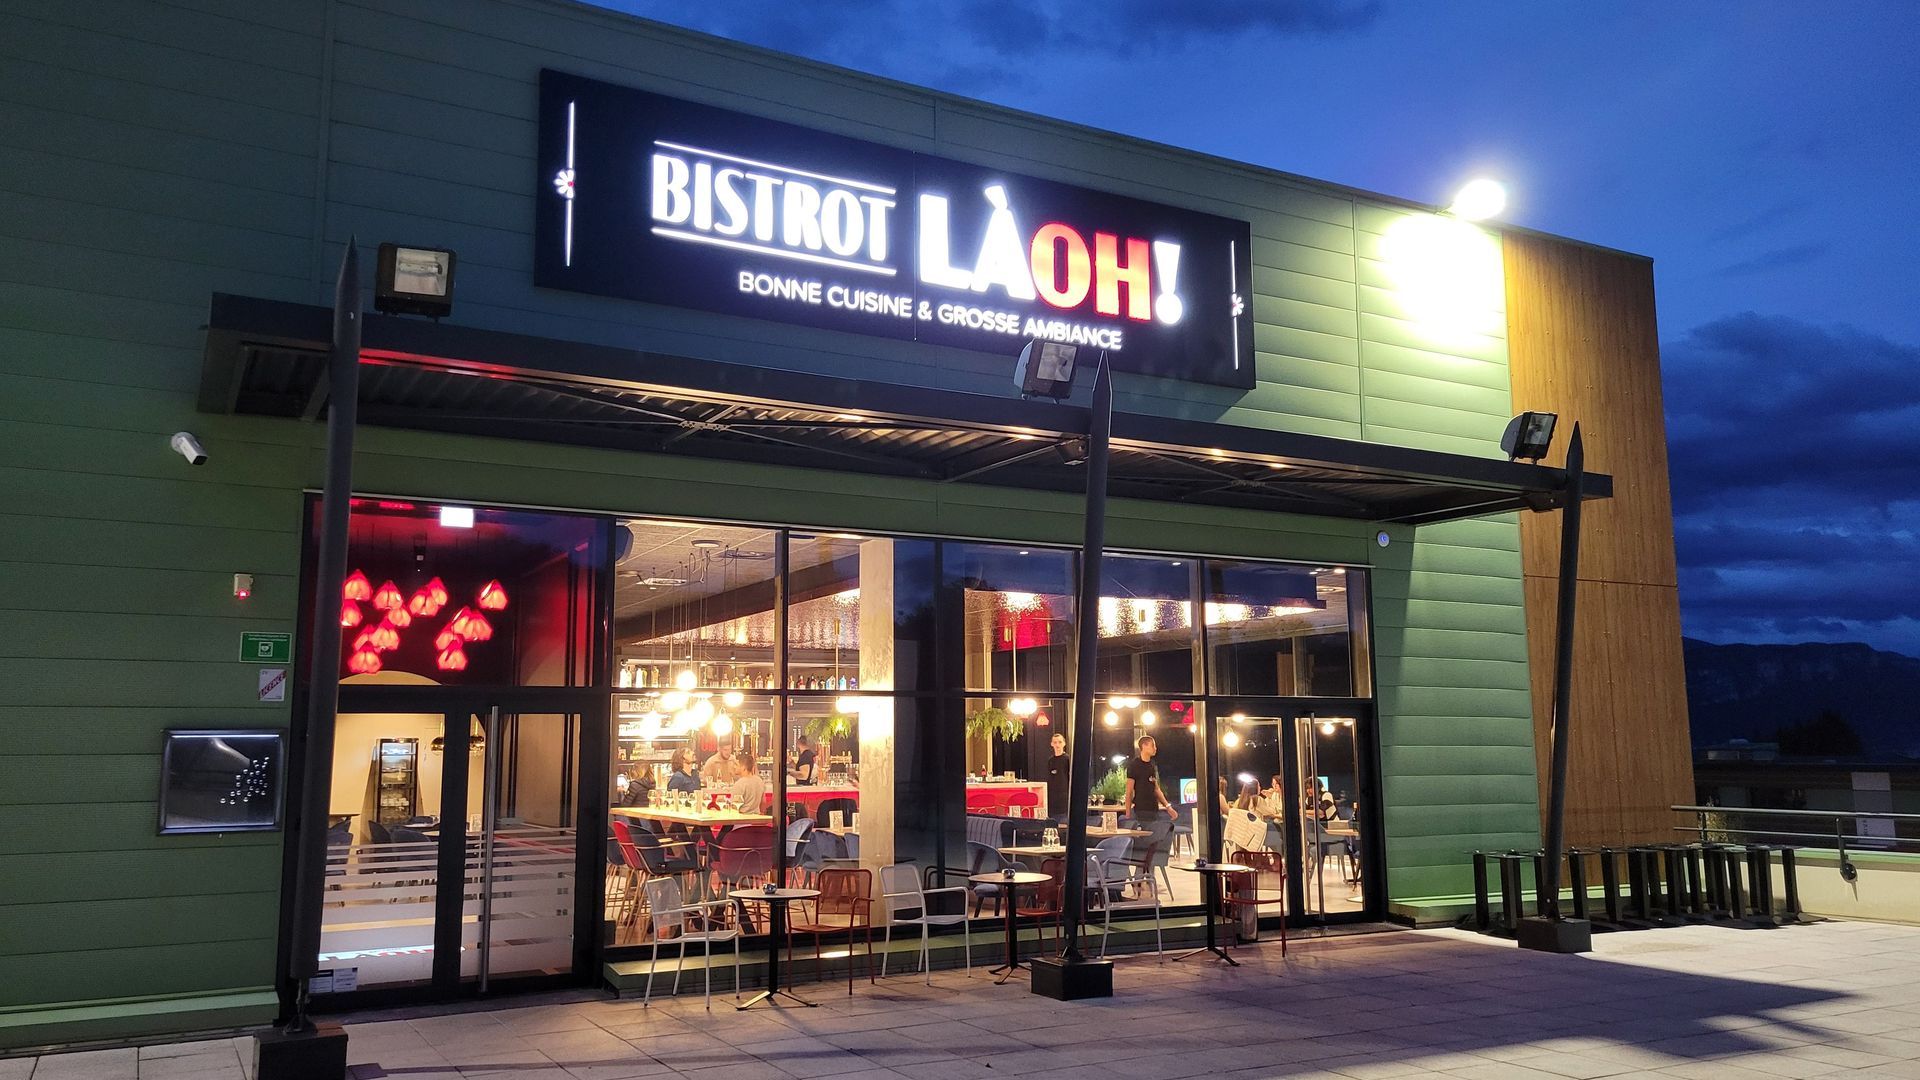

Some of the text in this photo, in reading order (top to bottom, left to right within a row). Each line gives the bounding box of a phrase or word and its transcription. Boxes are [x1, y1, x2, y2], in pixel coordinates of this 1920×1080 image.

[651, 153, 896, 262] BISTROT
[739, 271, 1122, 350] BONNE CUISINE & GROSSE AMBIANCE
